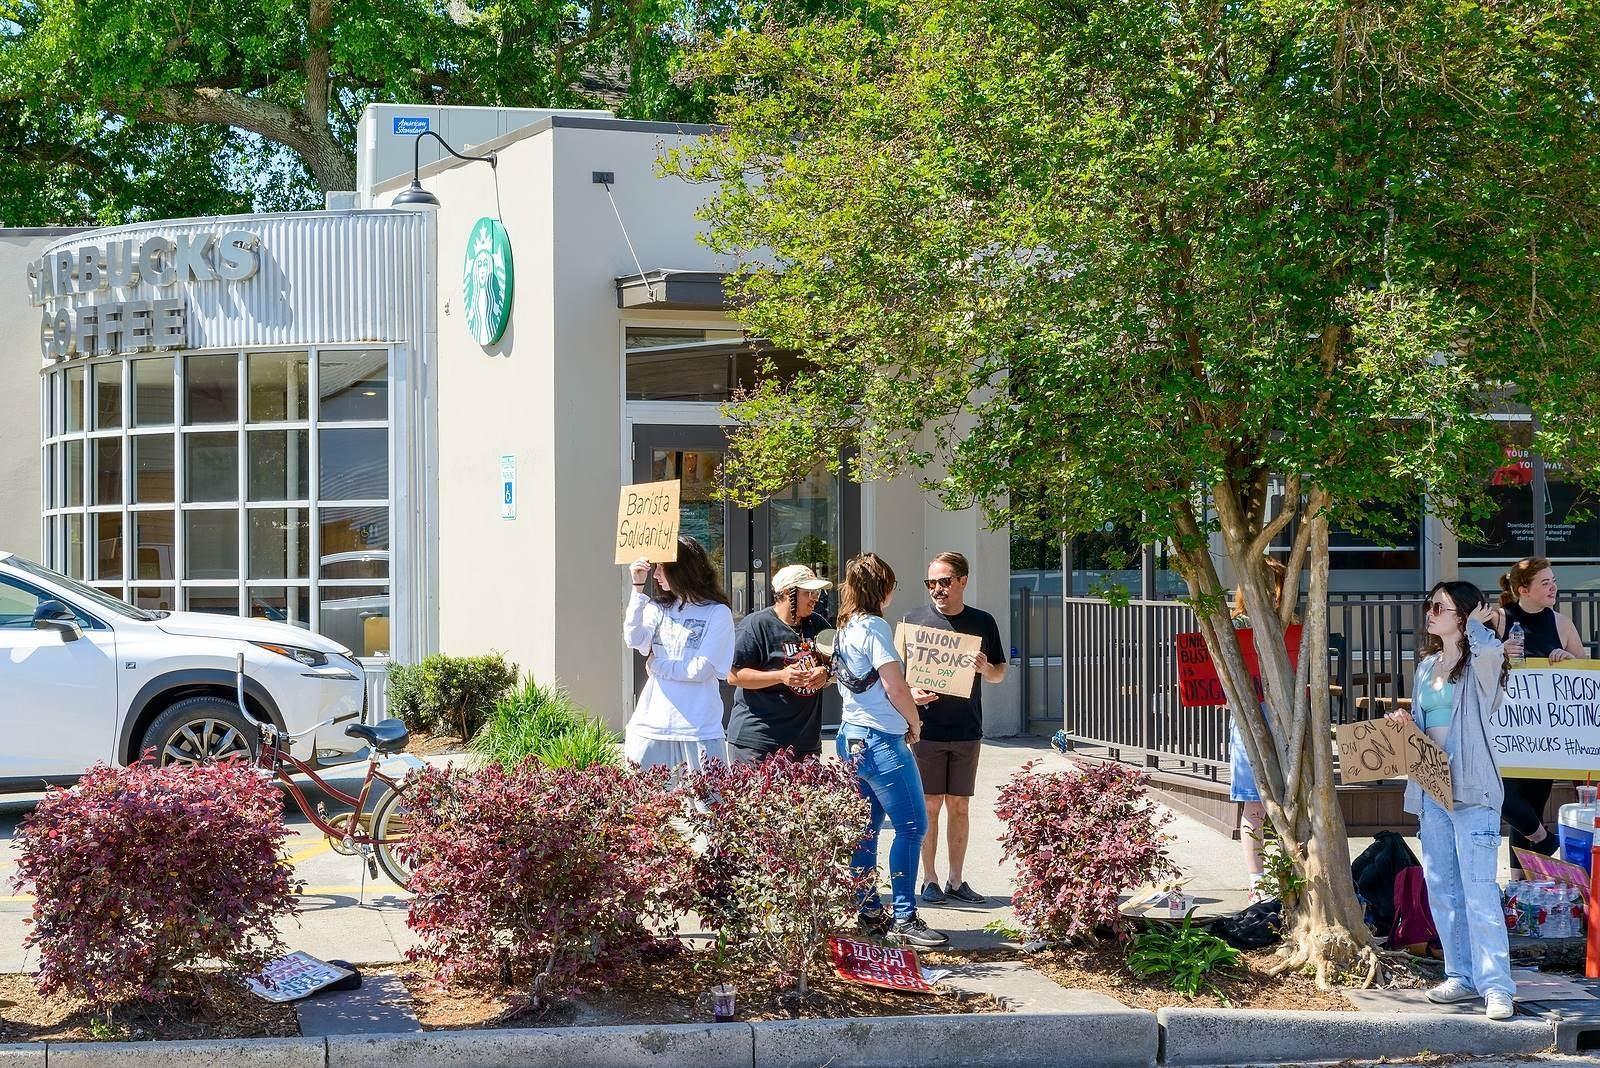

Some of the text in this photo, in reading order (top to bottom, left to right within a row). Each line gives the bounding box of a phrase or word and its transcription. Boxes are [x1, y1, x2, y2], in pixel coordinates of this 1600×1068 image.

[398, 118, 427, 126] American
[27, 230, 263, 307] STARBUCKS
[41, 299, 185, 359] COFFEE
[1507, 449, 1529, 458] YOUR
[1544, 462, 1564, 470] WAY.
[627, 488, 671, 516] Barista
[620, 519, 674, 550] Solidarity!
[915, 630, 962, 649] UNION
[906, 643, 971, 668] STRONG
[911, 664, 956, 677] ALL DAY
[916, 676, 947, 689] LONG
[1505, 673, 1543, 699] GHT
[1497, 703, 1541, 727] UNION
[1547, 702, 1600, 727] BUSTING
[1353, 720, 1377, 740] ON
[1361, 729, 1396, 770] ON
[1348, 765, 1360, 776] ON
[1384, 764, 1399, 776] ON
